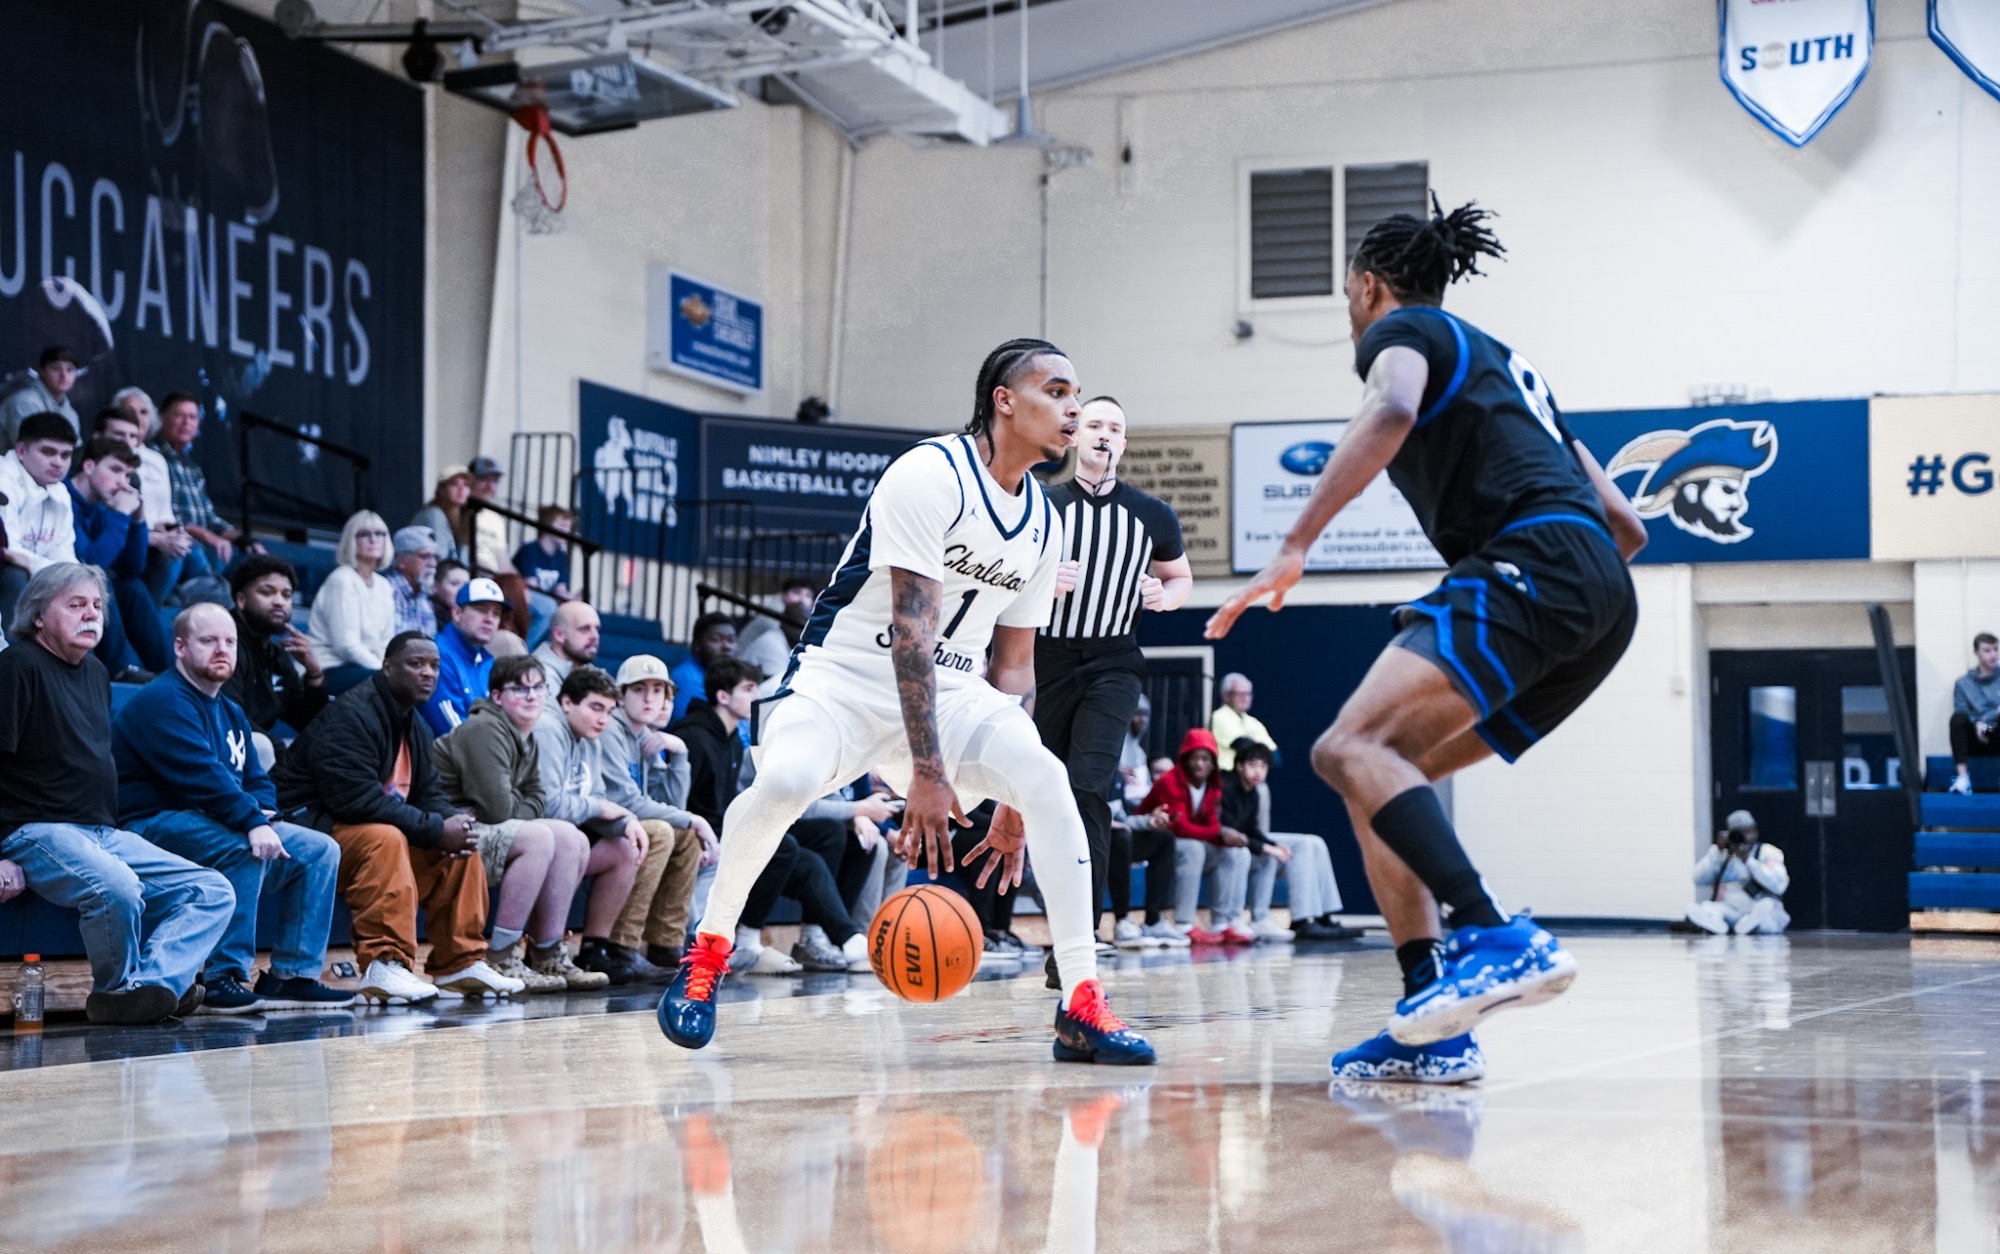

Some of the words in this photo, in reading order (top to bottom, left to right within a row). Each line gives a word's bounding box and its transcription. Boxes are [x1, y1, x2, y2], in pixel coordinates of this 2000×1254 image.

[722, 467, 848, 497] BASKETBALL
[1906, 451, 2000, 497] #G
[943, 589, 979, 640] 1
